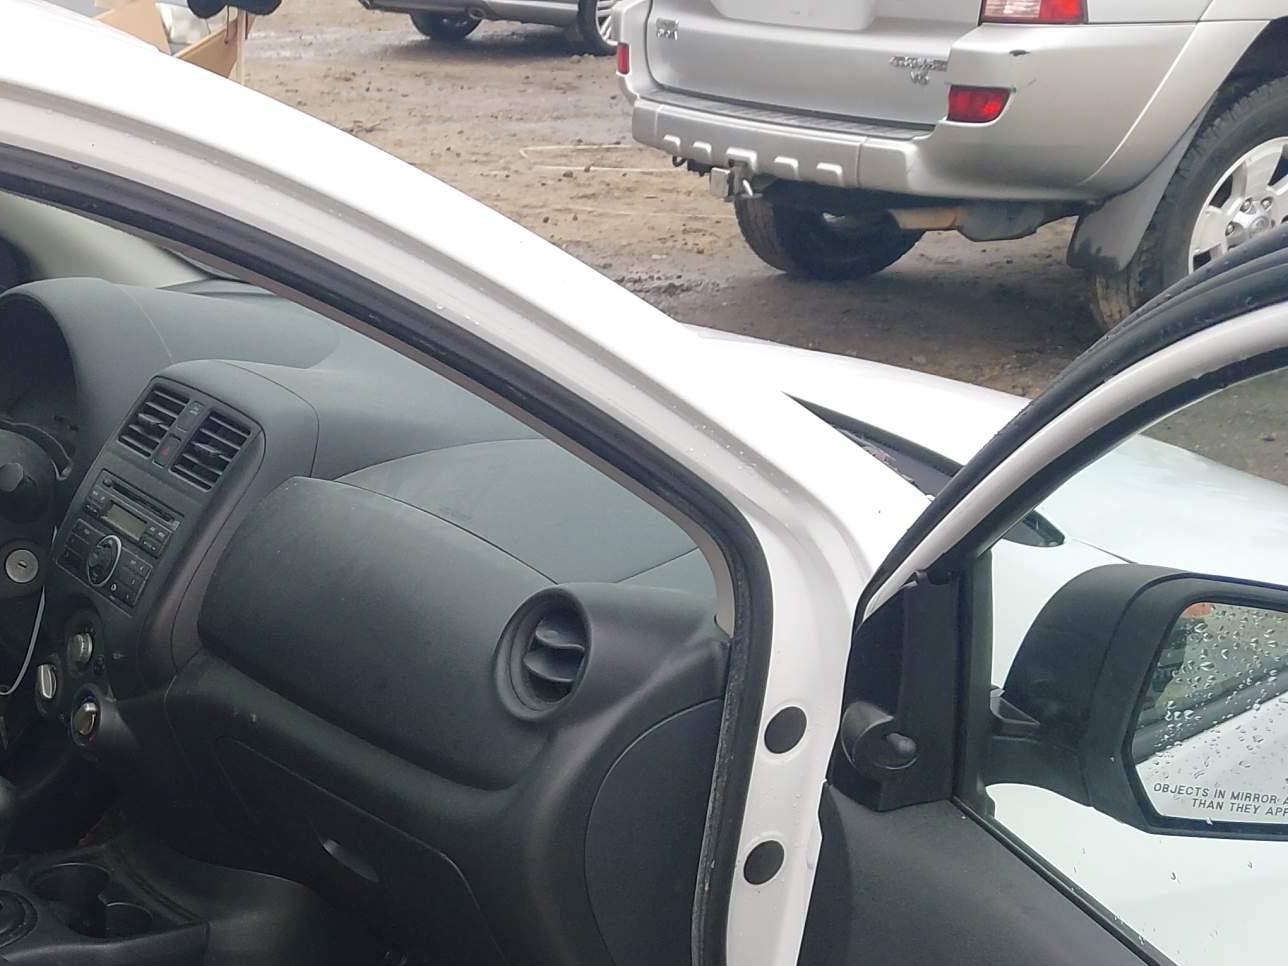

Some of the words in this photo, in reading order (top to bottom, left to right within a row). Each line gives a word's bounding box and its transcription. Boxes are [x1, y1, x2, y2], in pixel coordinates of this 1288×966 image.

[1153, 782, 1209, 797] OBJECTS
[1214, 788, 1226, 799] IN
[1230, 791, 1278, 804] MIRROR
[1192, 798, 1224, 811] THAN
[1230, 802, 1261, 815] THEY
